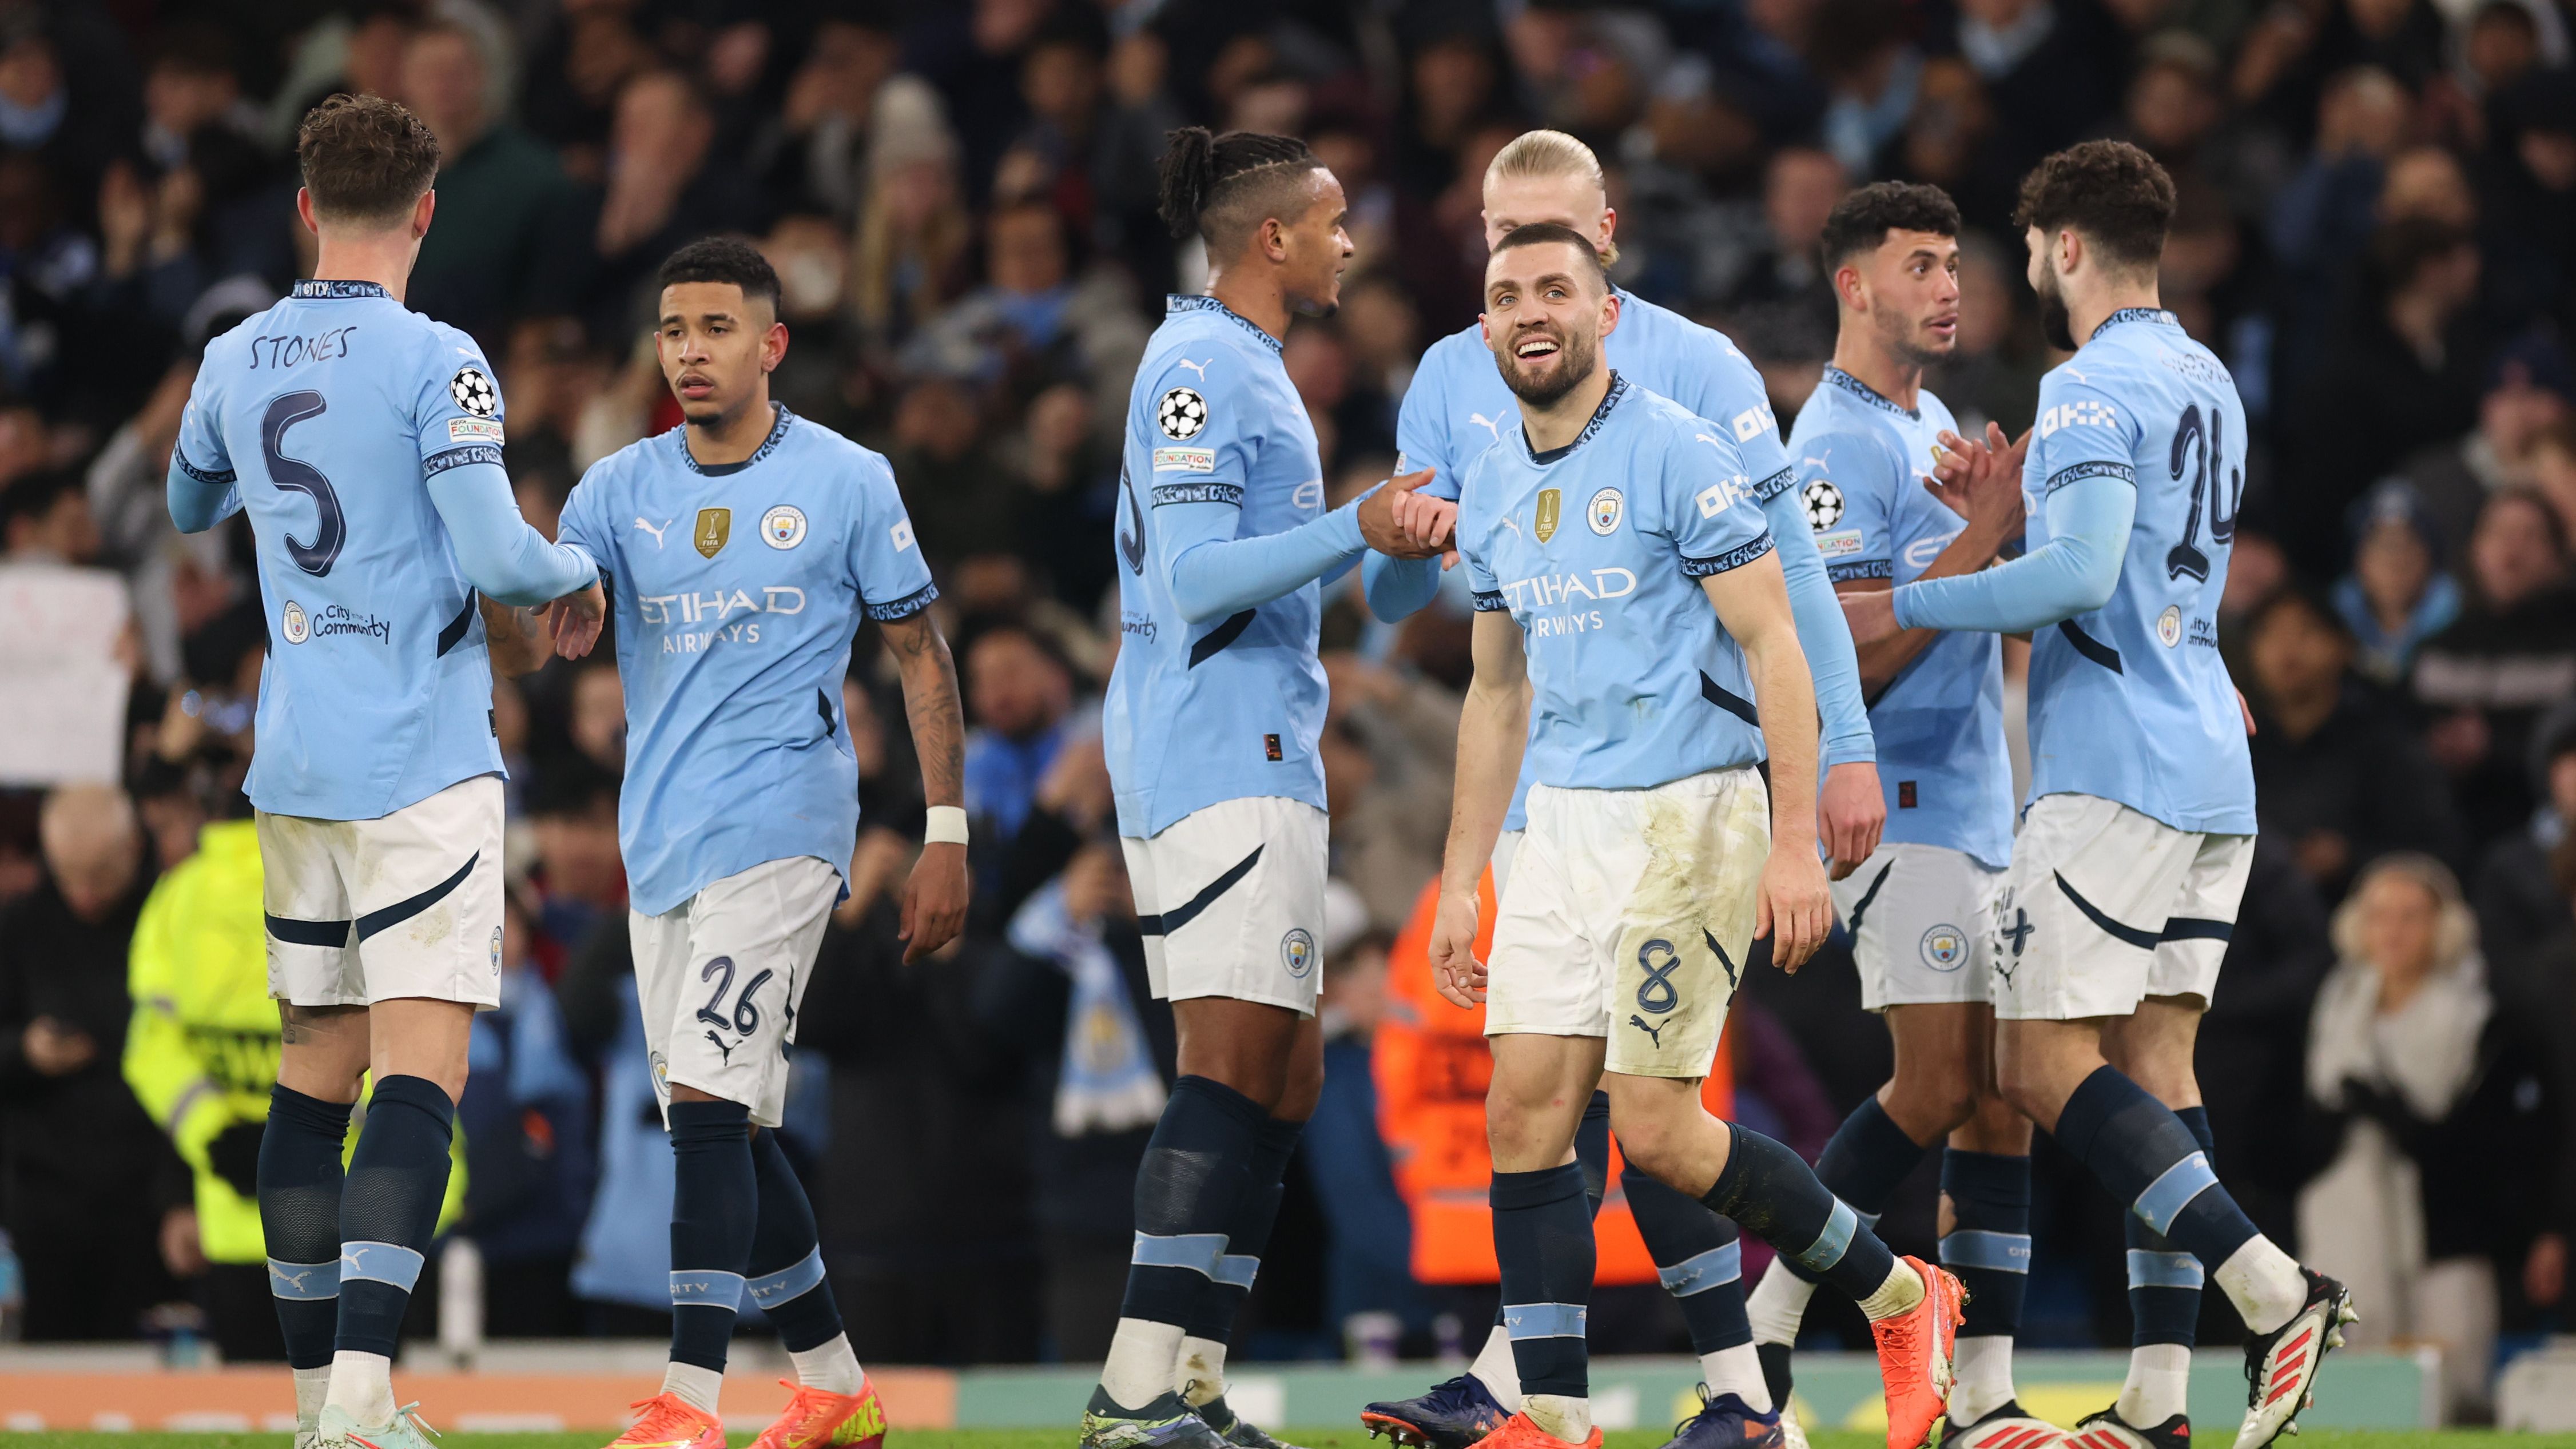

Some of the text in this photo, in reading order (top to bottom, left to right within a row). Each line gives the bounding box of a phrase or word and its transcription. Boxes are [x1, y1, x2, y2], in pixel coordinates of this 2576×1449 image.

[304, 283, 329, 295] CITY
[249, 326, 357, 369] STONES
[451, 425, 503, 436] FOUNDATION
[2041, 401, 2116, 440] OKX
[1154, 454, 1211, 464] FOUNDATION
[260, 389, 346, 578] 5
[1592, 491, 1622, 506] MANCHESTER
[2166, 401, 2240, 584] 24
[765, 508, 804, 522] MANCHESTER
[1540, 523, 1552, 531] FIFA
[1818, 538, 1861, 550] NDATION
[638, 586, 806, 624] ETIHAD
[1501, 567, 1637, 614] ETIHAD
[326, 604, 349, 620] City
[2190, 618, 2211, 634] ity
[313, 614, 390, 645] Community
[663, 624, 760, 654] AIRWAYS
[1122, 613, 1157, 644] unity
[1637, 938, 1681, 1014] 8
[697, 955, 773, 1037] 26
[832, 1395, 886, 1446] NIKE
